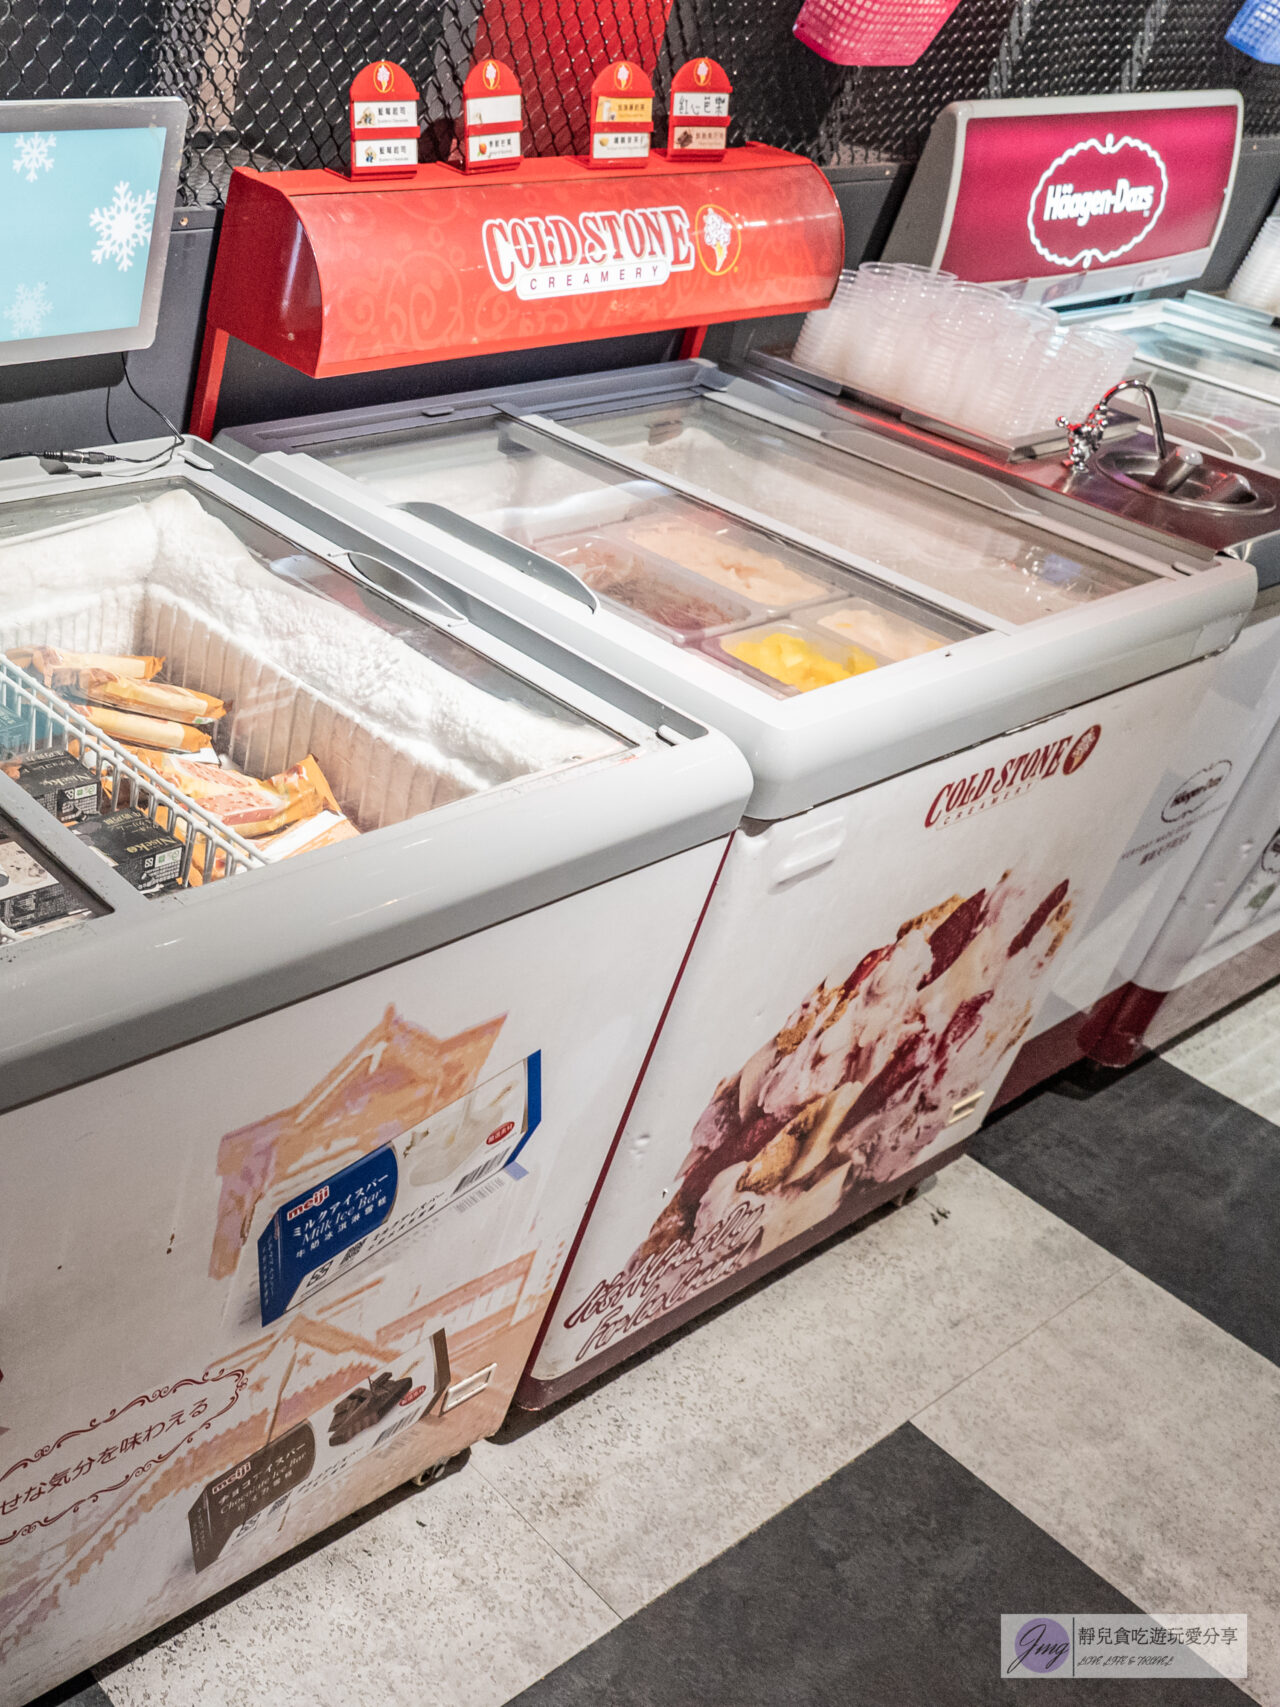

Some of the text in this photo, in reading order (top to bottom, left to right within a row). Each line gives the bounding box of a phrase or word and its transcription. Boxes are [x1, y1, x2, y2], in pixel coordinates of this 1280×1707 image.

[484, 207, 693, 288] COLD STONE
[530, 265, 660, 291] CREAMERY
[924, 735, 1073, 828] COLD STONE
[944, 783, 1033, 825] CREAMERY
[287, 1185, 330, 1221] meiji
[293, 1174, 389, 1237] ミルクアイスバー
[302, 1189, 382, 1245] Milk Ice Bar
[212, 1461, 251, 1495] meiji
